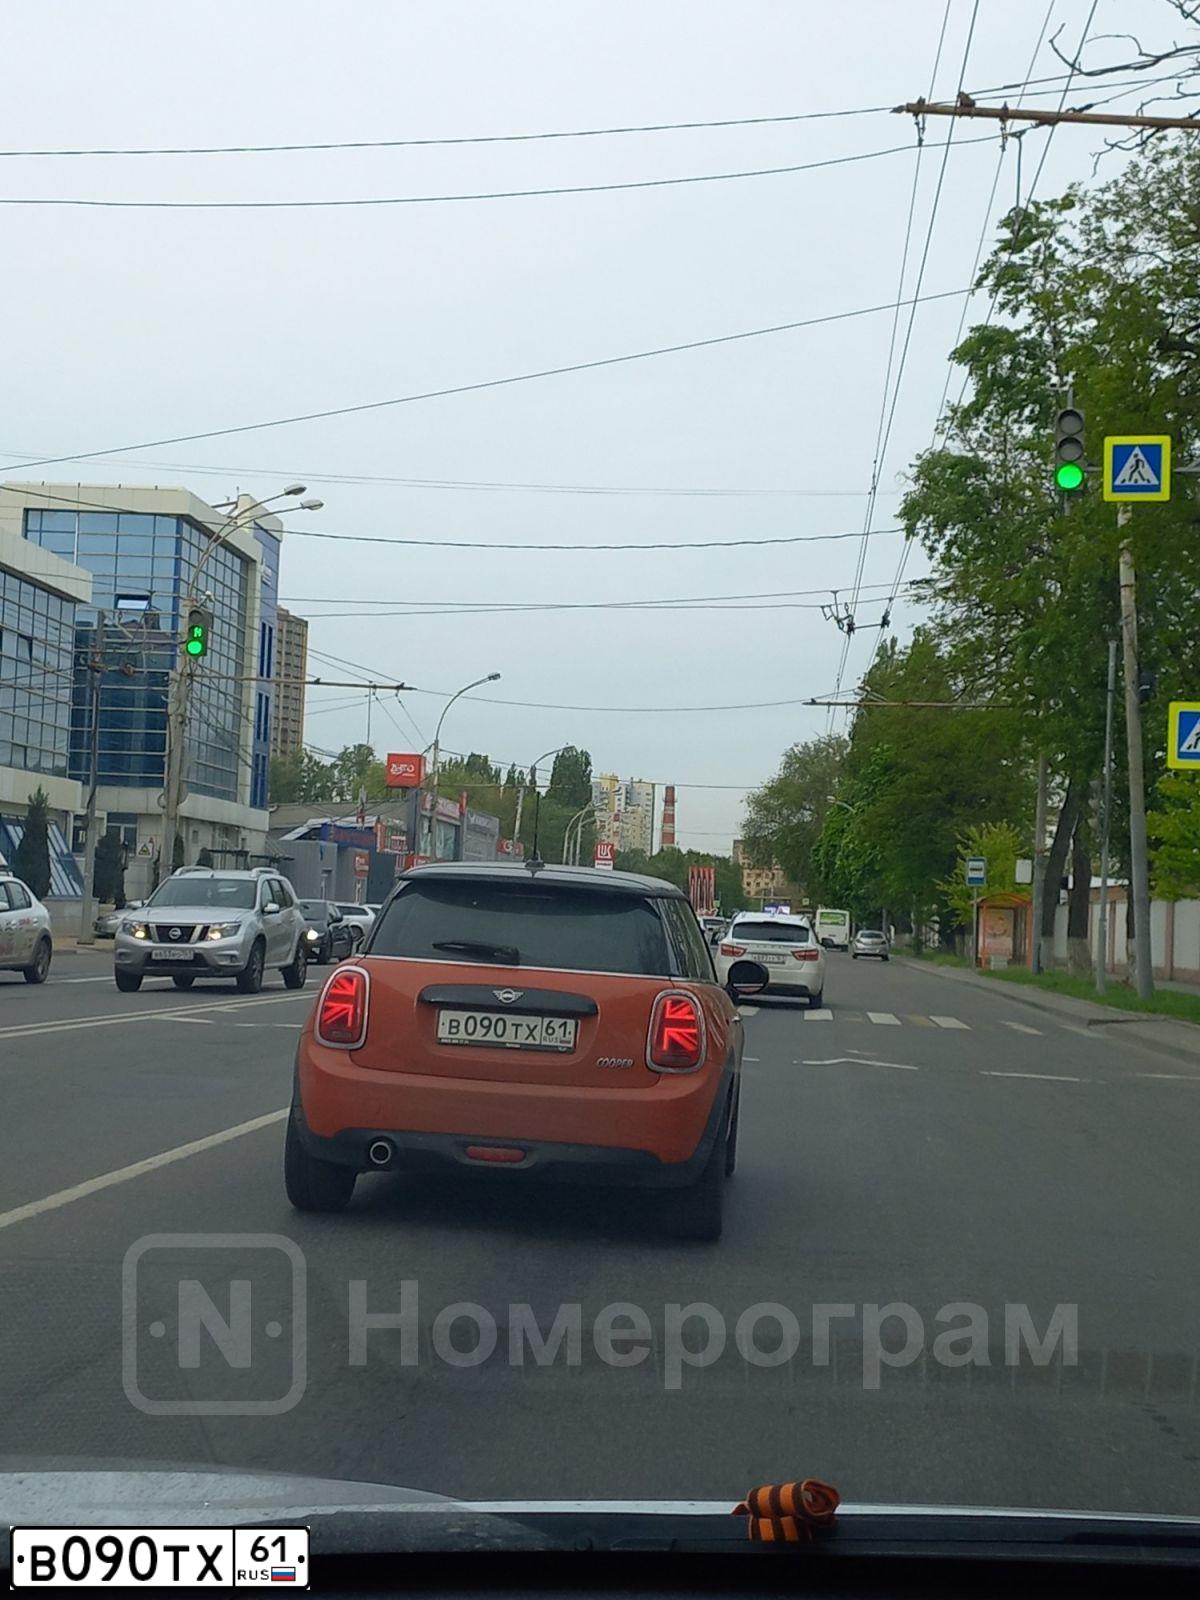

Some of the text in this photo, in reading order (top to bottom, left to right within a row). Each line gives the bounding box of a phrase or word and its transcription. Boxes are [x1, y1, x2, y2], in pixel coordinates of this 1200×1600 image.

[448, 1015, 567, 1042] В090ТХ 61
[596, 1057, 634, 1068] COOPER
